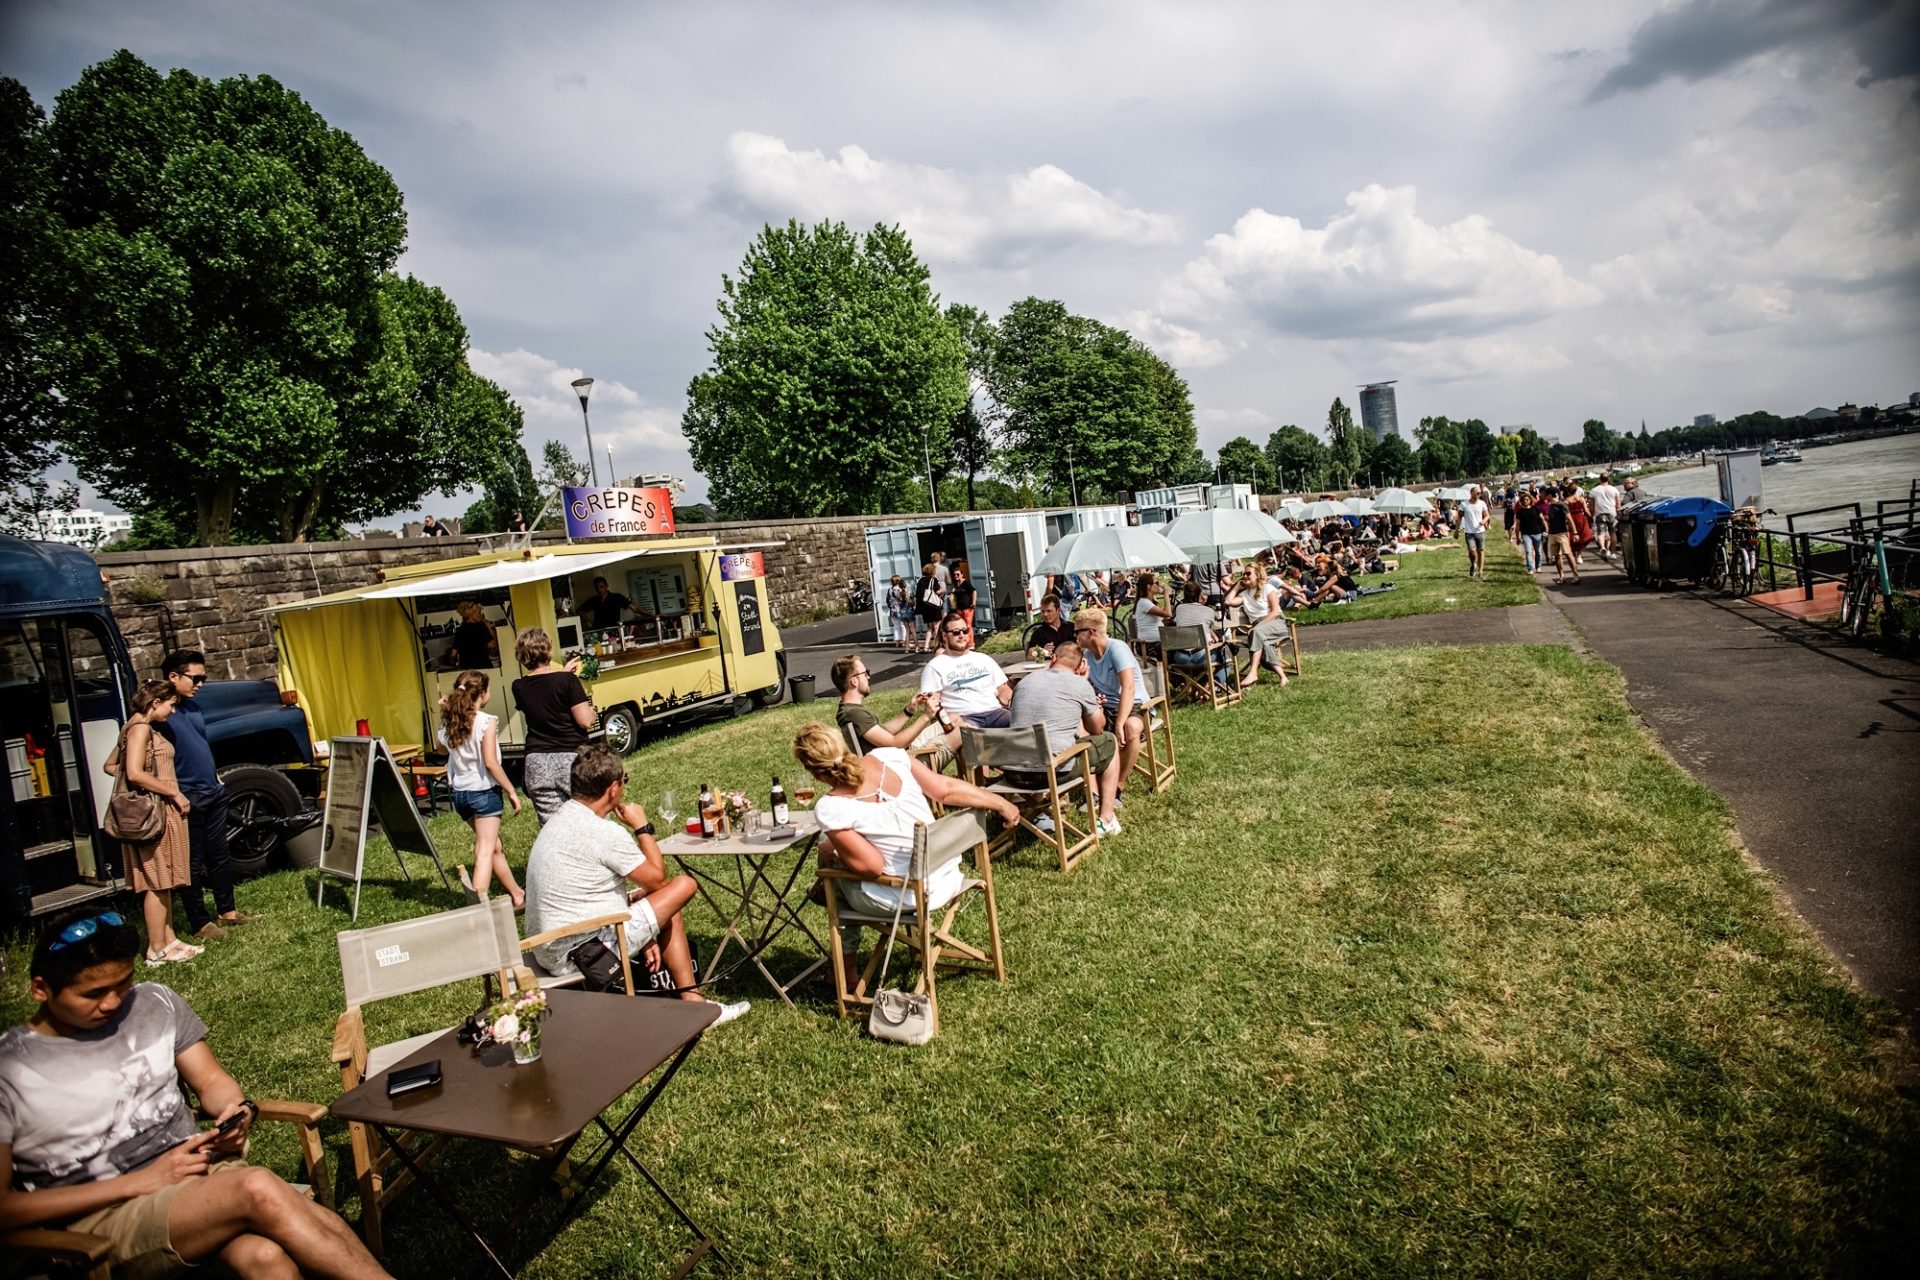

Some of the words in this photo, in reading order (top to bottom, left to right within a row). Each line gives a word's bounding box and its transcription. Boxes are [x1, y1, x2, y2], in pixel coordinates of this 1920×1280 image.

[572, 488, 656, 520] CRÊPES
[591, 520, 605, 533] de
[608, 518, 647, 532] France
